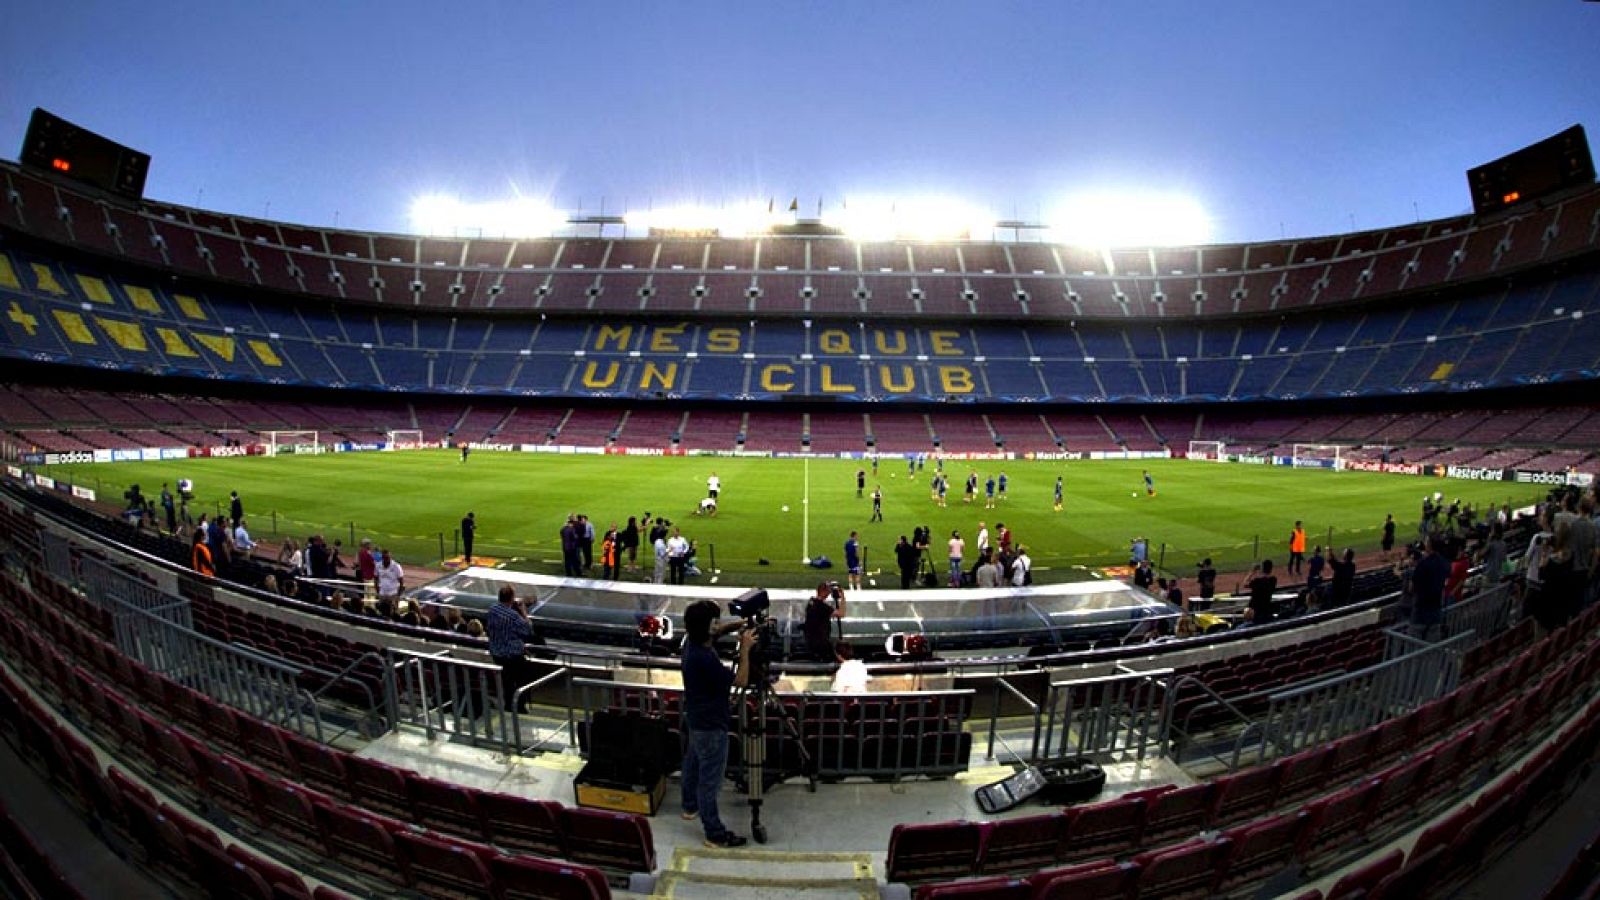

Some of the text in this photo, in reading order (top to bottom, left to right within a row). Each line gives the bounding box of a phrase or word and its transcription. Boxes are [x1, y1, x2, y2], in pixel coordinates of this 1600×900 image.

[595, 322, 964, 354] MÉS QUE
[582, 361, 975, 393] UN CLUB
[1447, 465, 1503, 480] MasterCard
[1533, 471, 1565, 484] adidas
